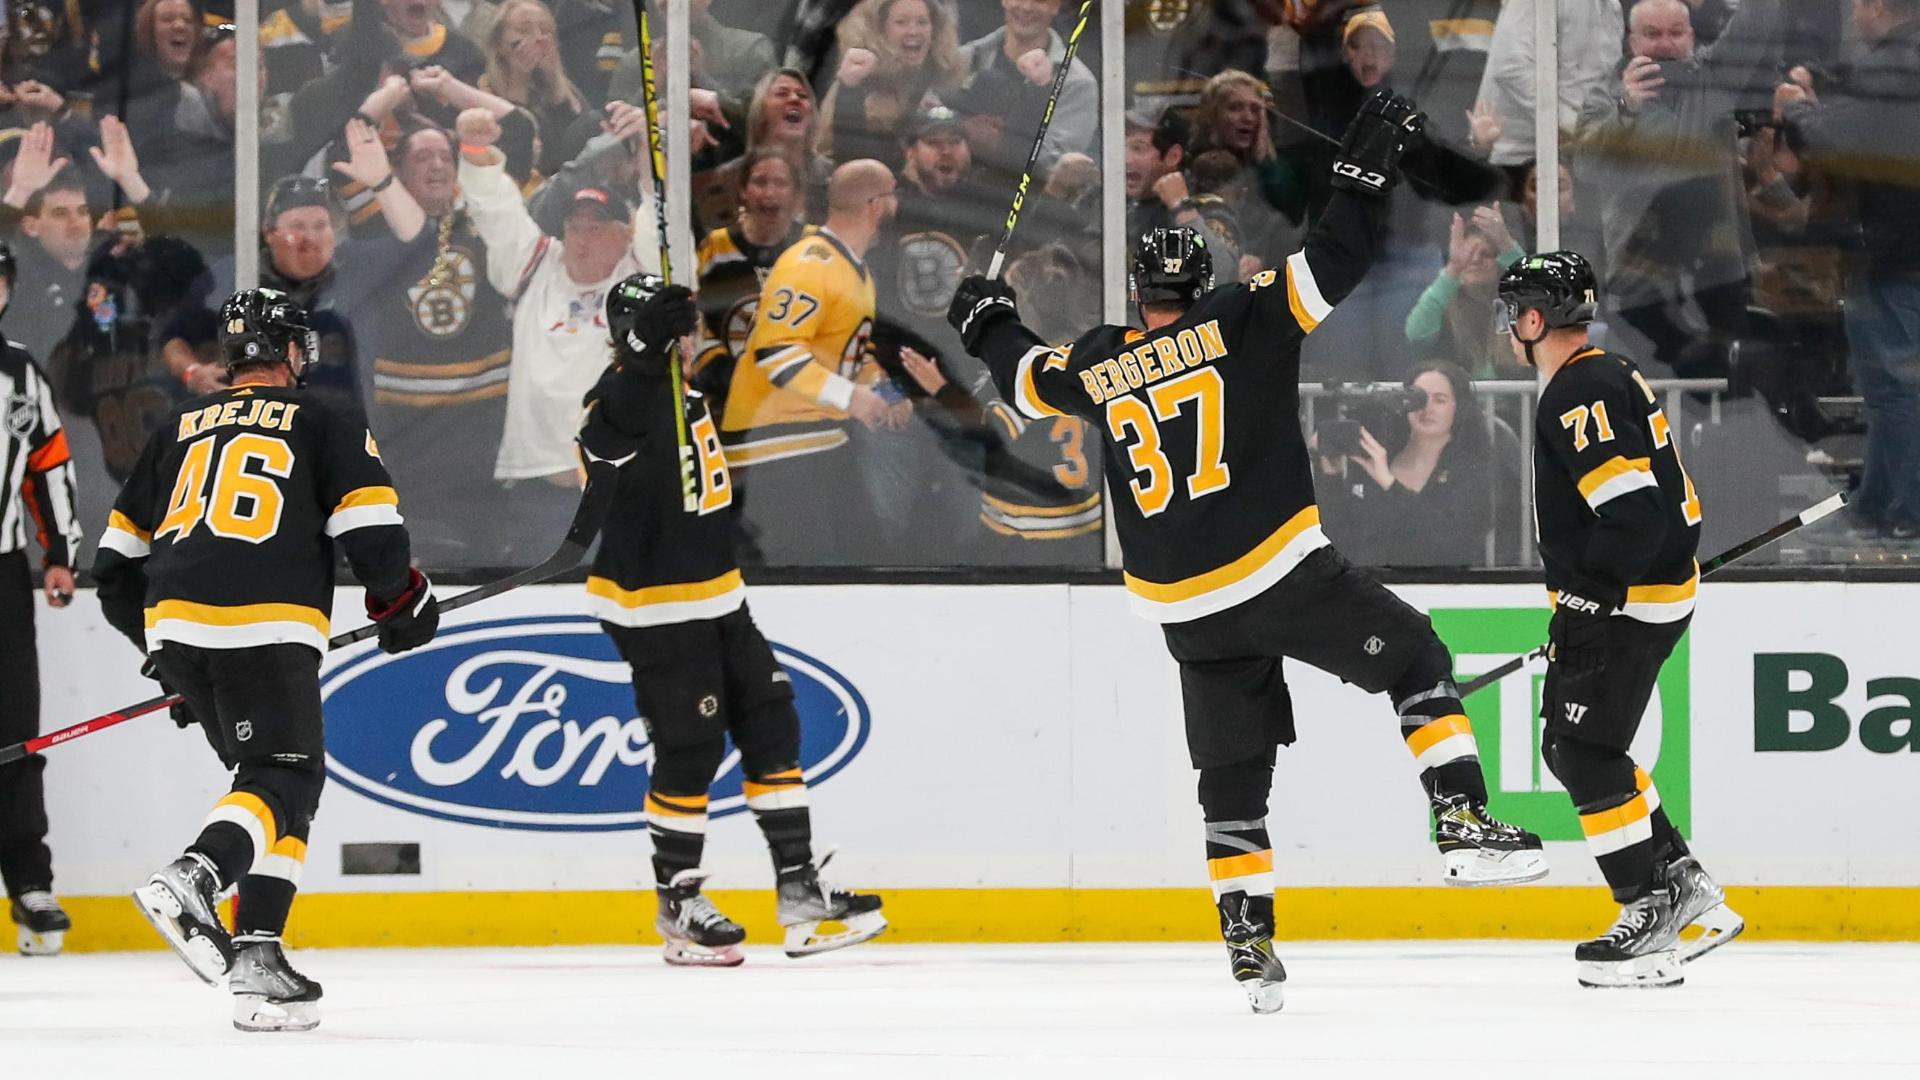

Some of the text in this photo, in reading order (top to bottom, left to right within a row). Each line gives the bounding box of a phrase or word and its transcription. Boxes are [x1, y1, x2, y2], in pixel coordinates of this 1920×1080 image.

[1006, 172, 1031, 230] CCM
[1163, 257, 1183, 274] 37
[767, 288, 820, 330] 37
[1584, 288, 1596, 304] 71
[226, 318, 245, 335] 46
[1078, 319, 1229, 405] BERGERON
[177, 399, 299, 442] KREJCI
[1106, 365, 1231, 519] 37
[1559, 400, 1615, 453] 71
[153, 432, 296, 545] 46
[1753, 652, 1920, 754] Ba
[51, 725, 89, 744] BAUER
